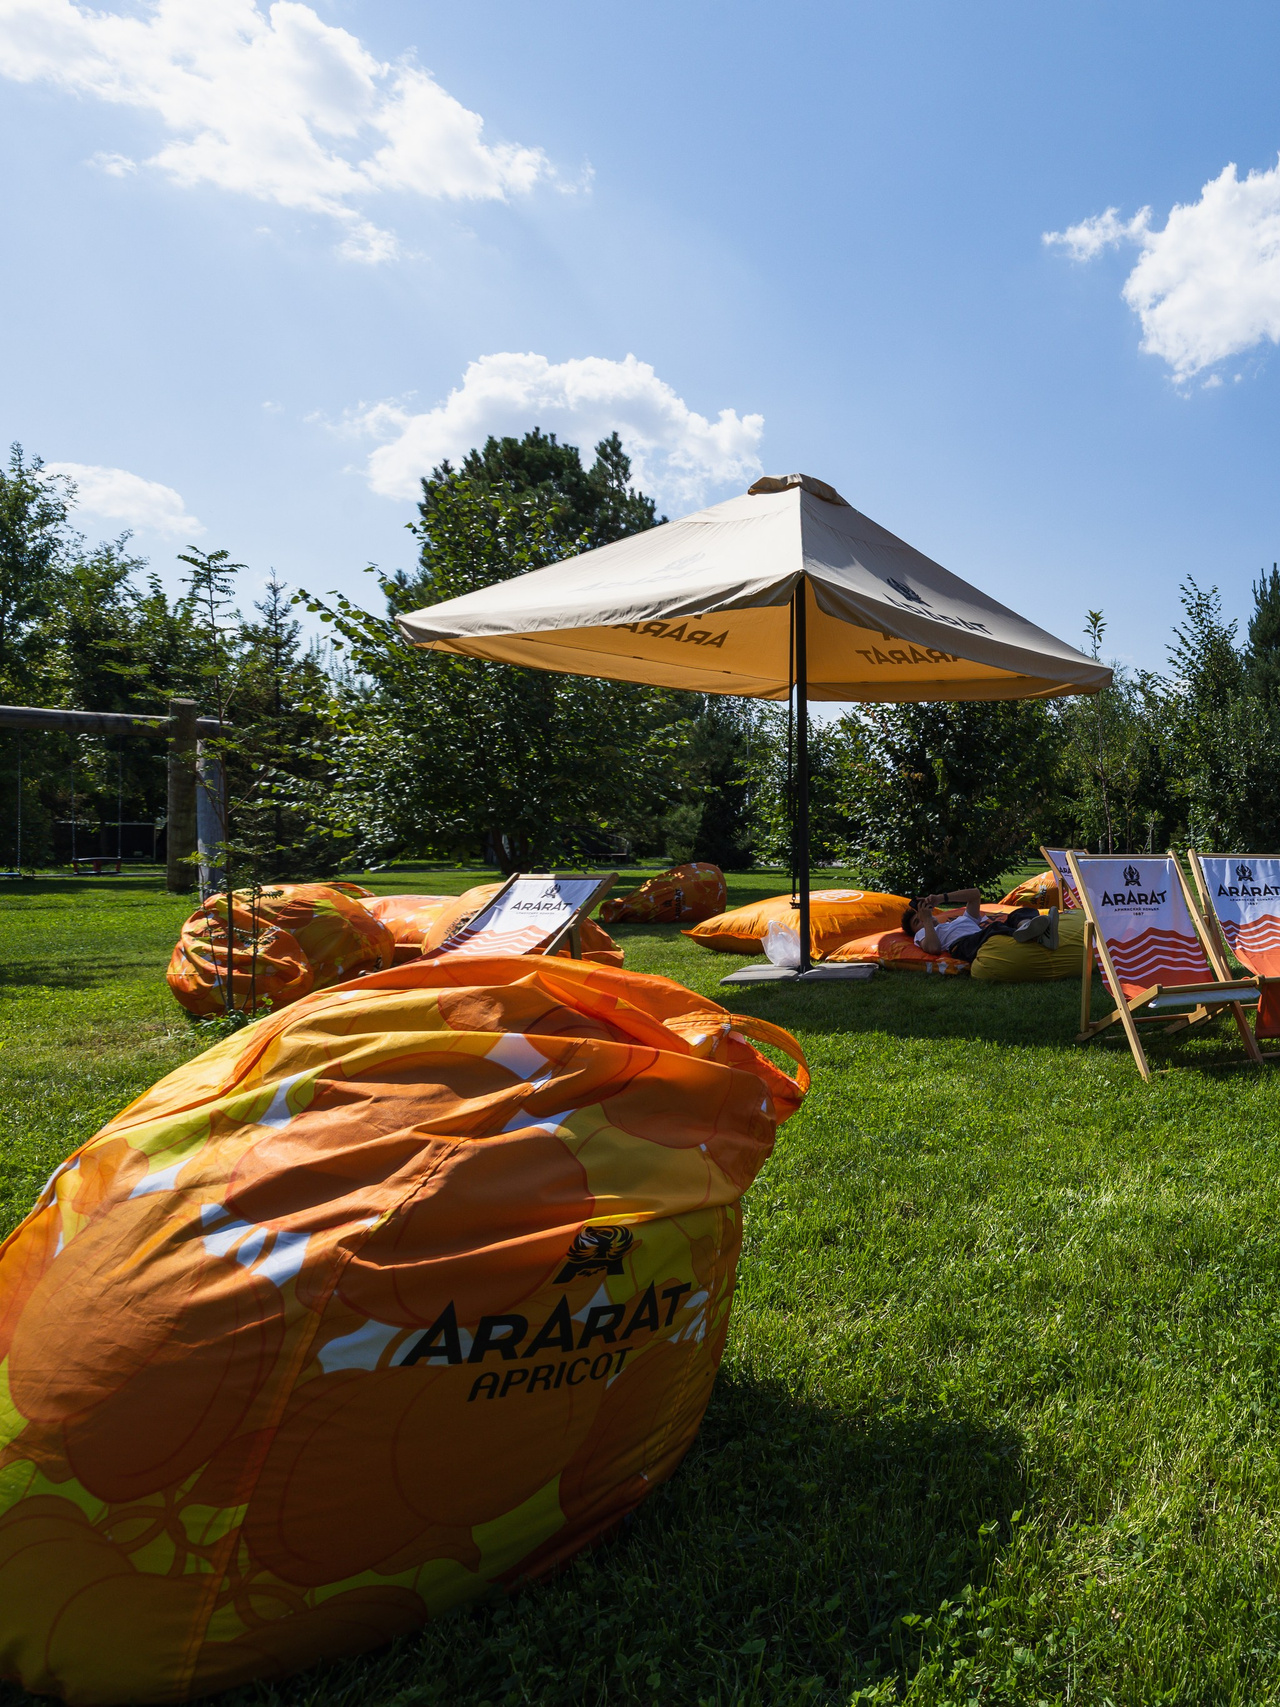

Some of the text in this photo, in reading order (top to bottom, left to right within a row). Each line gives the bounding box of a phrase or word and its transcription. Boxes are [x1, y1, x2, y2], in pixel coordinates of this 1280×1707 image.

[1101, 889, 1167, 907] ARARAT
[1217, 883, 1280, 897] ARARAT
[510, 900, 573, 911] ARARAT
[400, 1280, 692, 1366] ARARAT
[467, 1347, 633, 1402] APRICOT
